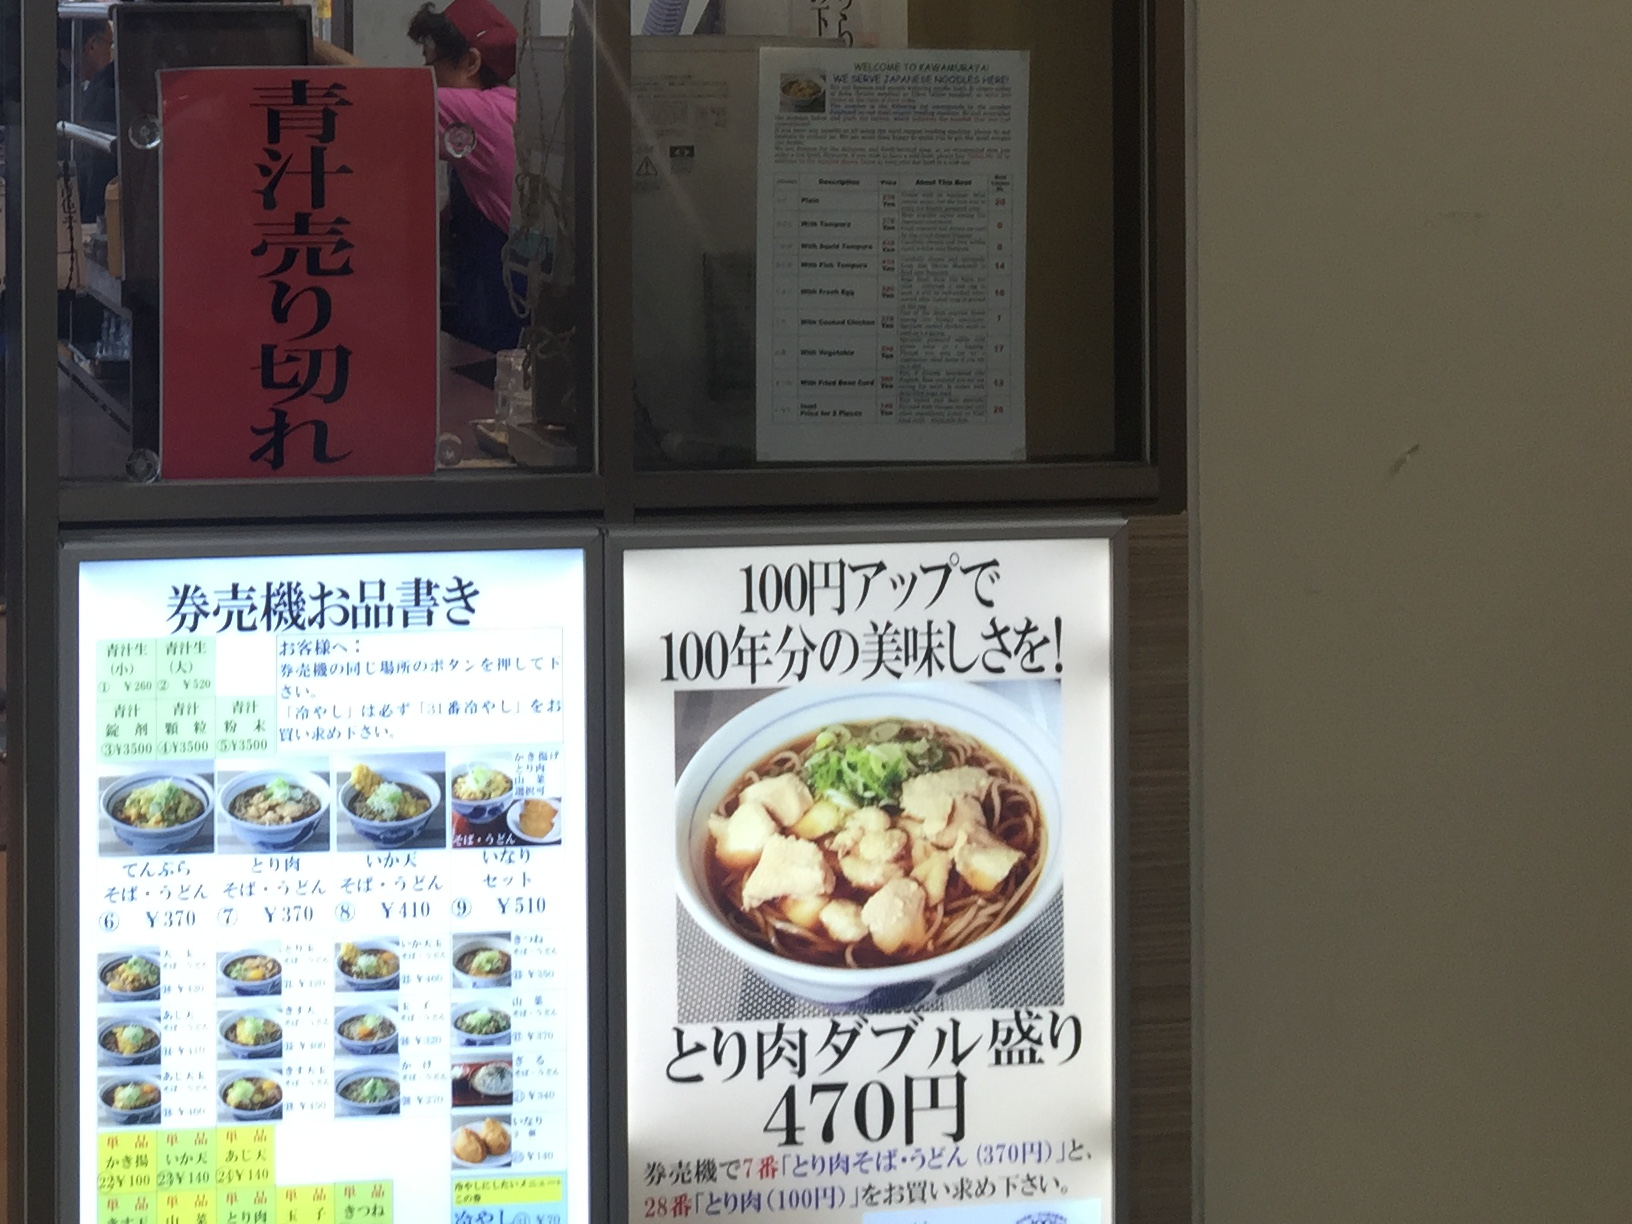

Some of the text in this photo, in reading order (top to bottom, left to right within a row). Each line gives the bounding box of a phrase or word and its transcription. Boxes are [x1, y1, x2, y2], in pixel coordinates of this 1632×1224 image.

[854, 62, 899, 72] WELCOME
[902, 62, 918, 72] TO
[833, 75, 849, 84] WE
[851, 75, 880, 84] SERVE
[934, 75, 980, 84] NOODLES
[248, 78, 354, 471] 青汁売り切れ
[738, 551, 1000, 618] 100円アップで
[166, 575, 482, 635] 券売機お品書き
[106, 642, 148, 658] 青汁生
[166, 640, 207, 656] 青汁生
[659, 616, 1064, 684] 100年分の美味しさを!
[114, 703, 140, 719] 青汁
[173, 701, 199, 717] 青汁
[232, 700, 258, 715] 青汁
[250, 856, 301, 874] とり肉
[481, 847, 532, 865] いなり
[481, 871, 533, 889] セット
[264, 905, 314, 924] ¥370
[381, 900, 431, 919] ¥410
[497, 896, 547, 915] ¥510
[146, 909, 196, 928] ¥370
[665, 1006, 1084, 1085] とり肉ダブル盛り
[762, 1071, 968, 1148] 470円
